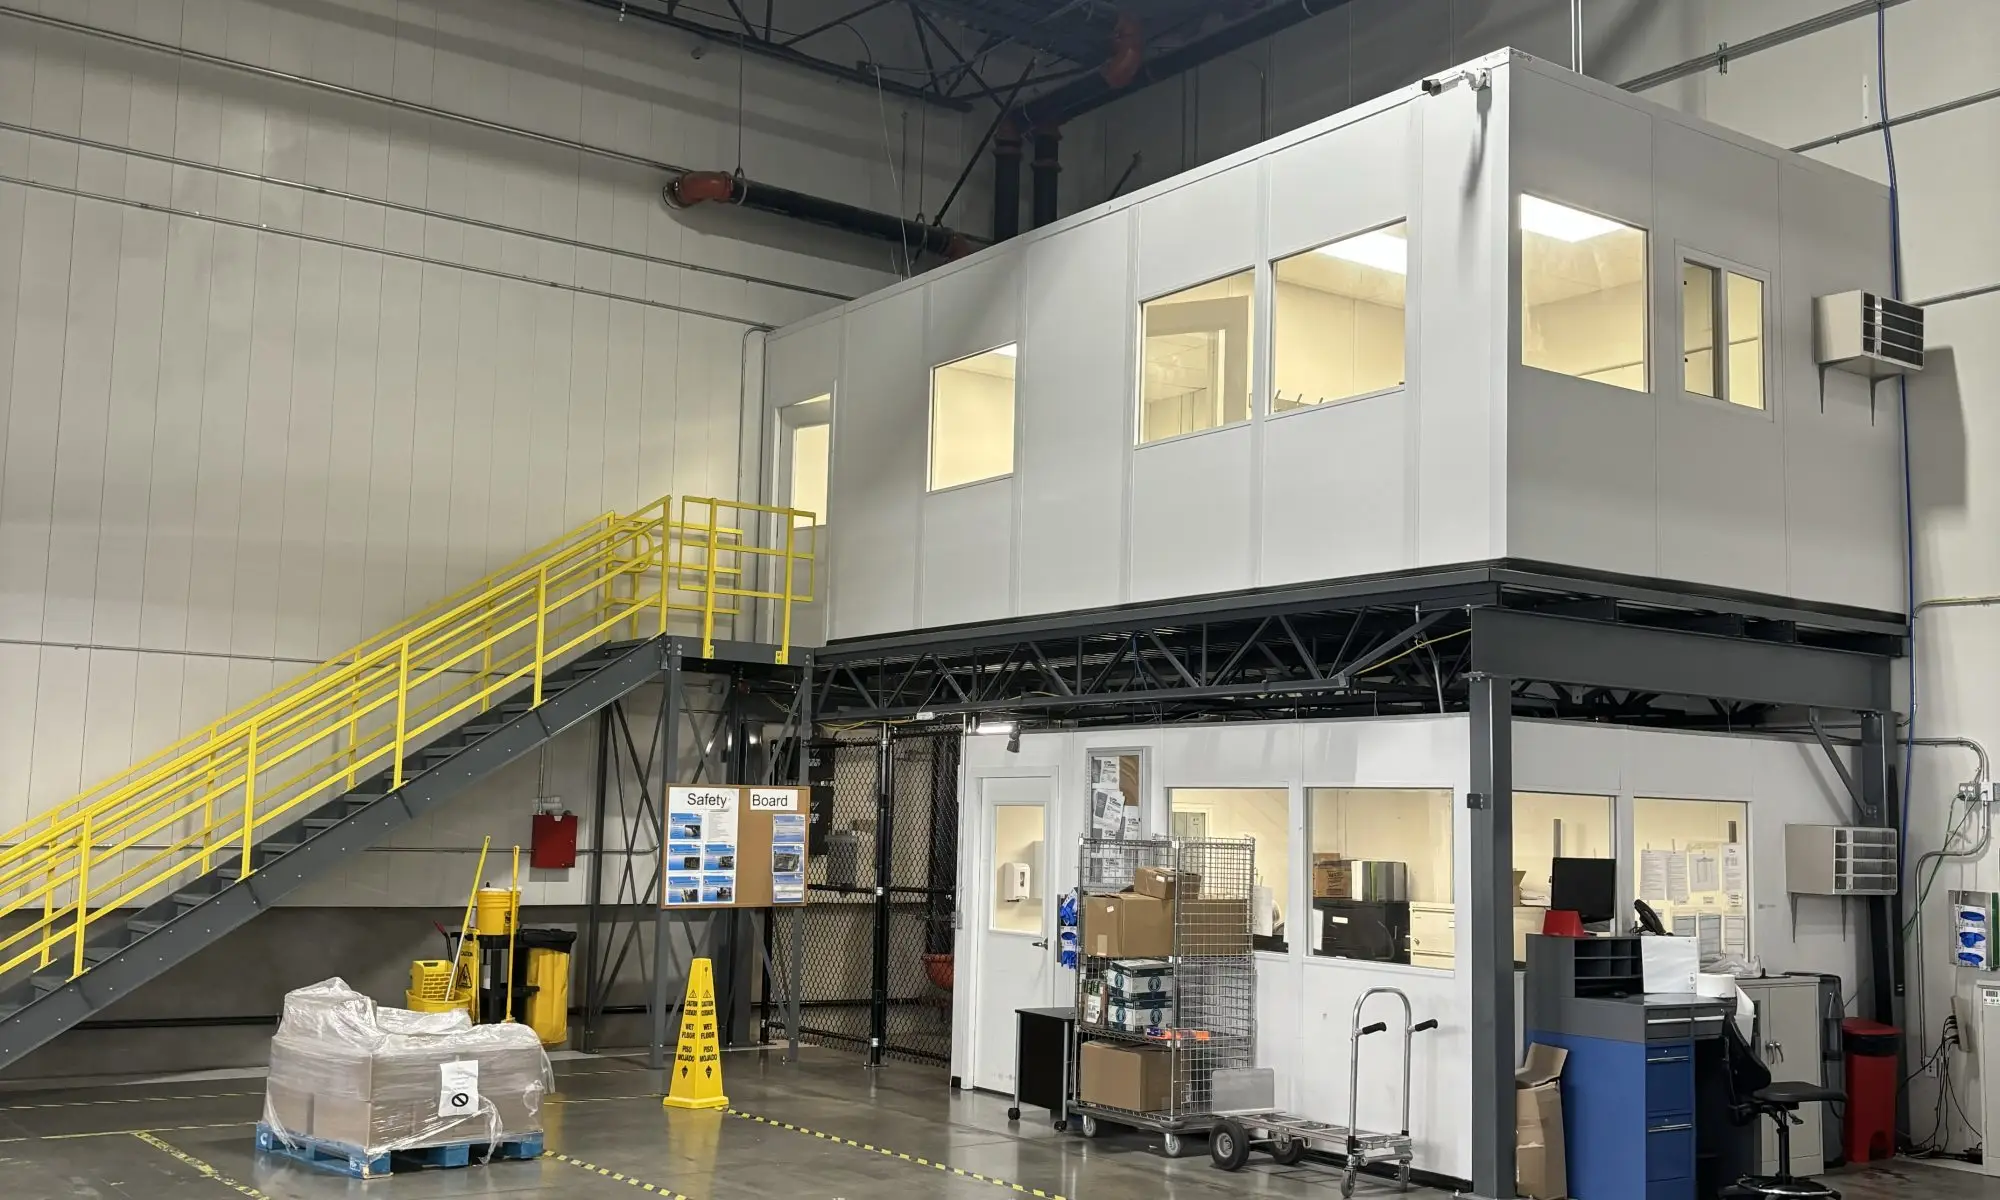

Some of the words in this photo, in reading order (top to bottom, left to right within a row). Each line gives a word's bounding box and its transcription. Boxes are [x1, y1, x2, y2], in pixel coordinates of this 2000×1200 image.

[687, 792, 727, 808] Safety
[752, 794, 788, 807] Board
[682, 1031, 695, 1039] FLOOR
[701, 1031, 715, 1039] FLOOR
[682, 1045, 692, 1053] PISO
[703, 1045, 713, 1053] PISO
[678, 1054, 695, 1062] MOJADO
[700, 1054, 717, 1062] MOJADO
